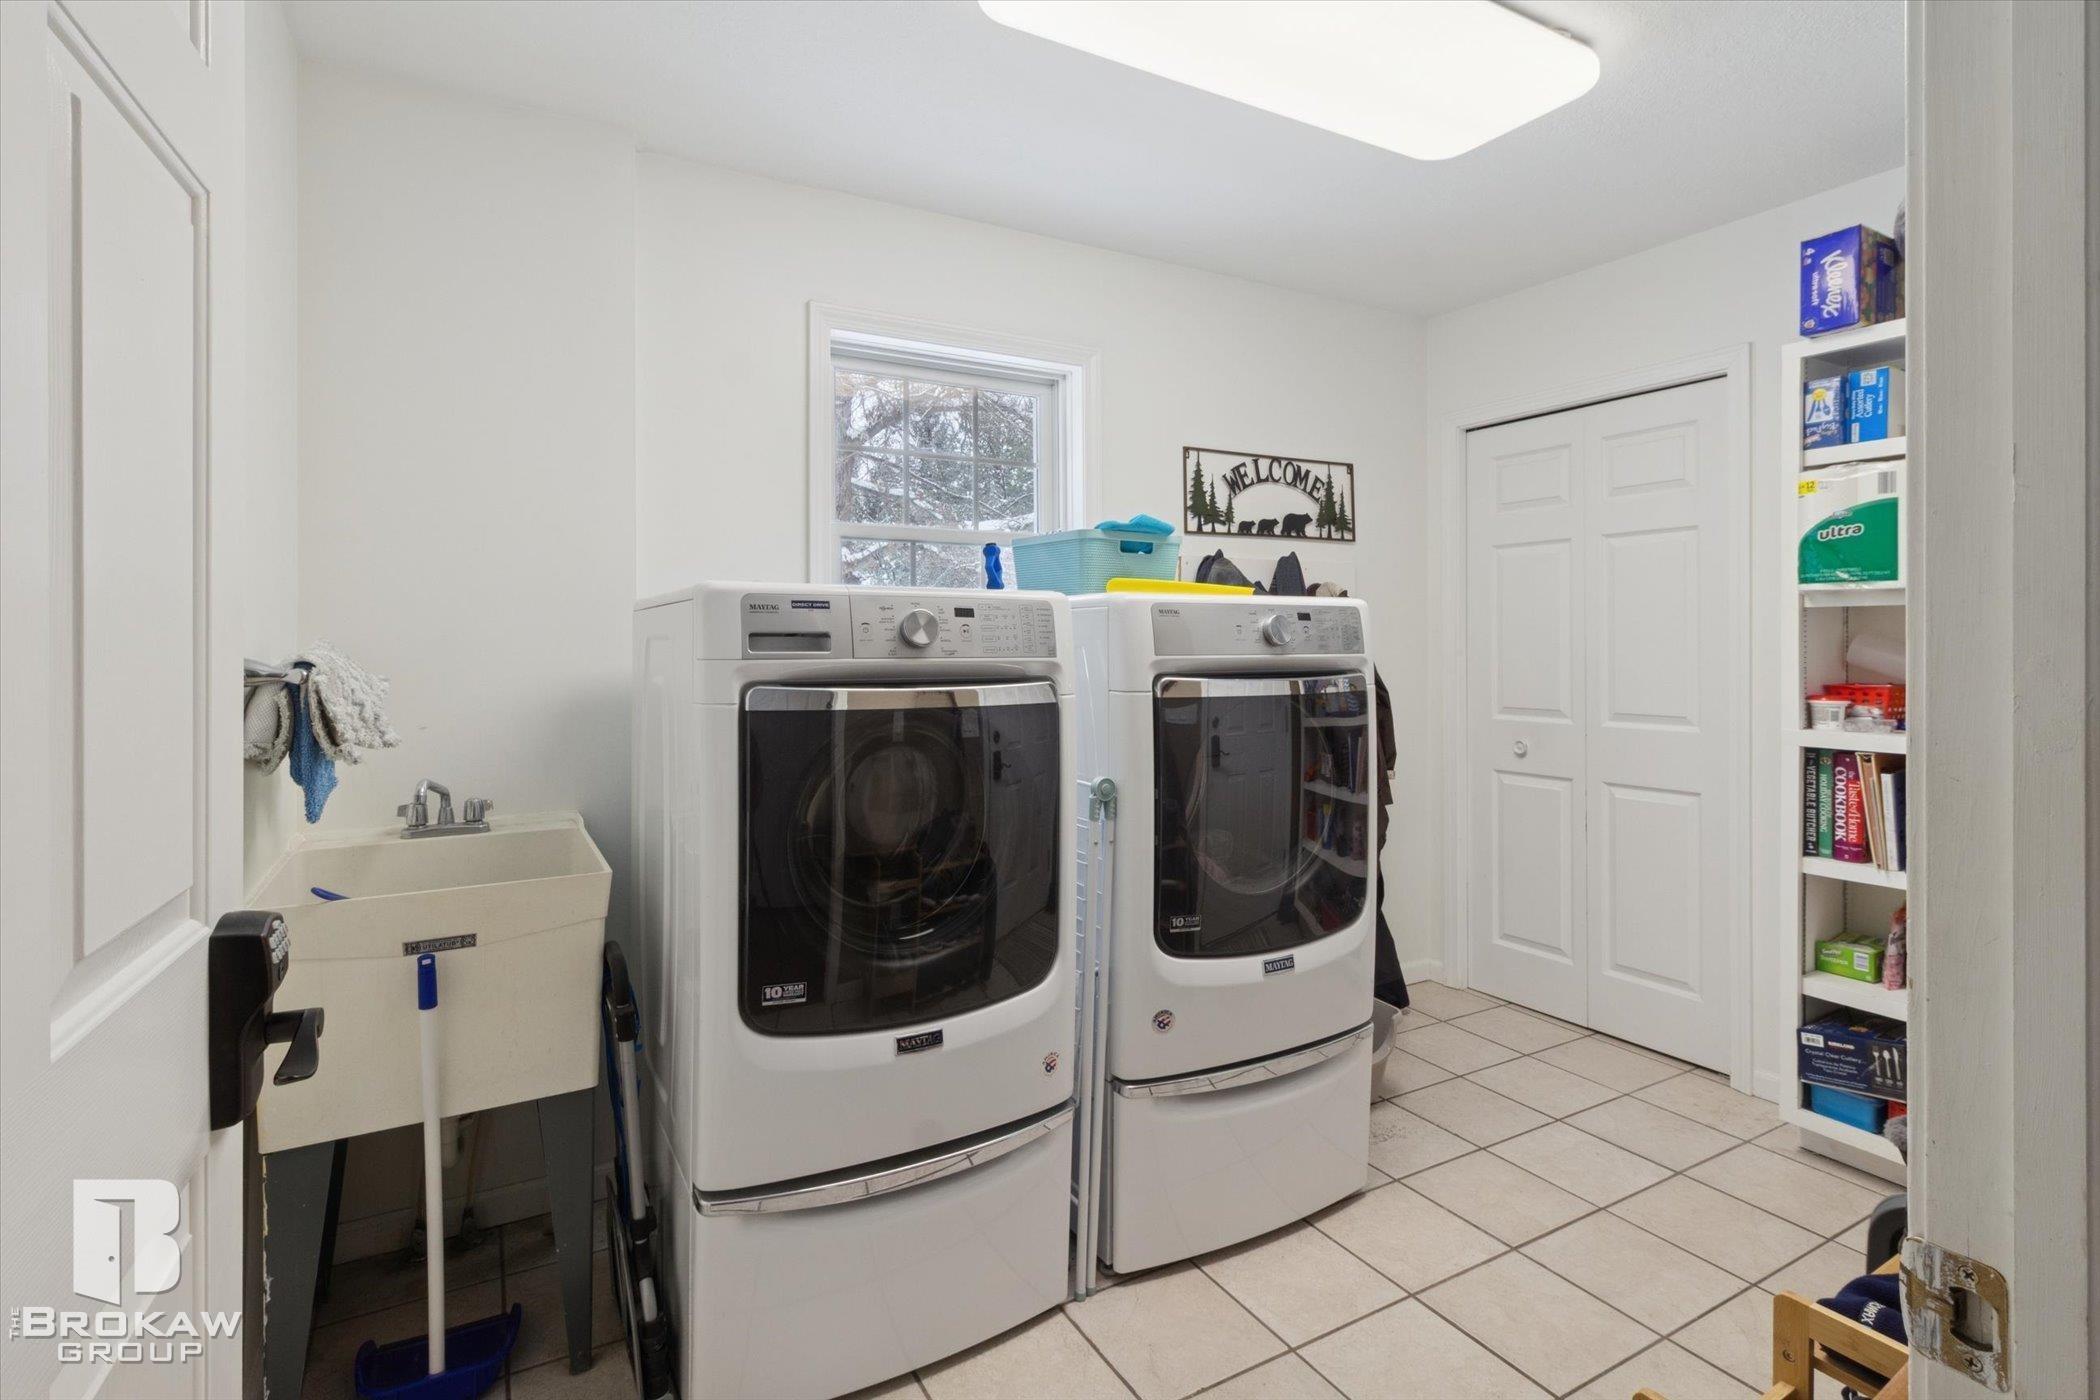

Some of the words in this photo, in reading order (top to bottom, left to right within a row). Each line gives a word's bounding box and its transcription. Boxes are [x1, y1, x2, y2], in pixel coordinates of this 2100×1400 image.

[1820, 250, 1848, 318] Kleenex
[1222, 458, 1325, 501] WELCOME
[1819, 524, 1863, 541] ultra
[1806, 765, 1816, 807] VEGETABLE
[1848, 781, 1861, 807] Taste
[1835, 766, 1847, 842] COOKBOOK
[1806, 808, 1816, 841] BUTCHER
[1848, 814, 1861, 842] Home
[1172, 917, 1184, 927] 10
[1265, 959, 1294, 972] MAYTAG
[764, 986, 782, 999] 10
